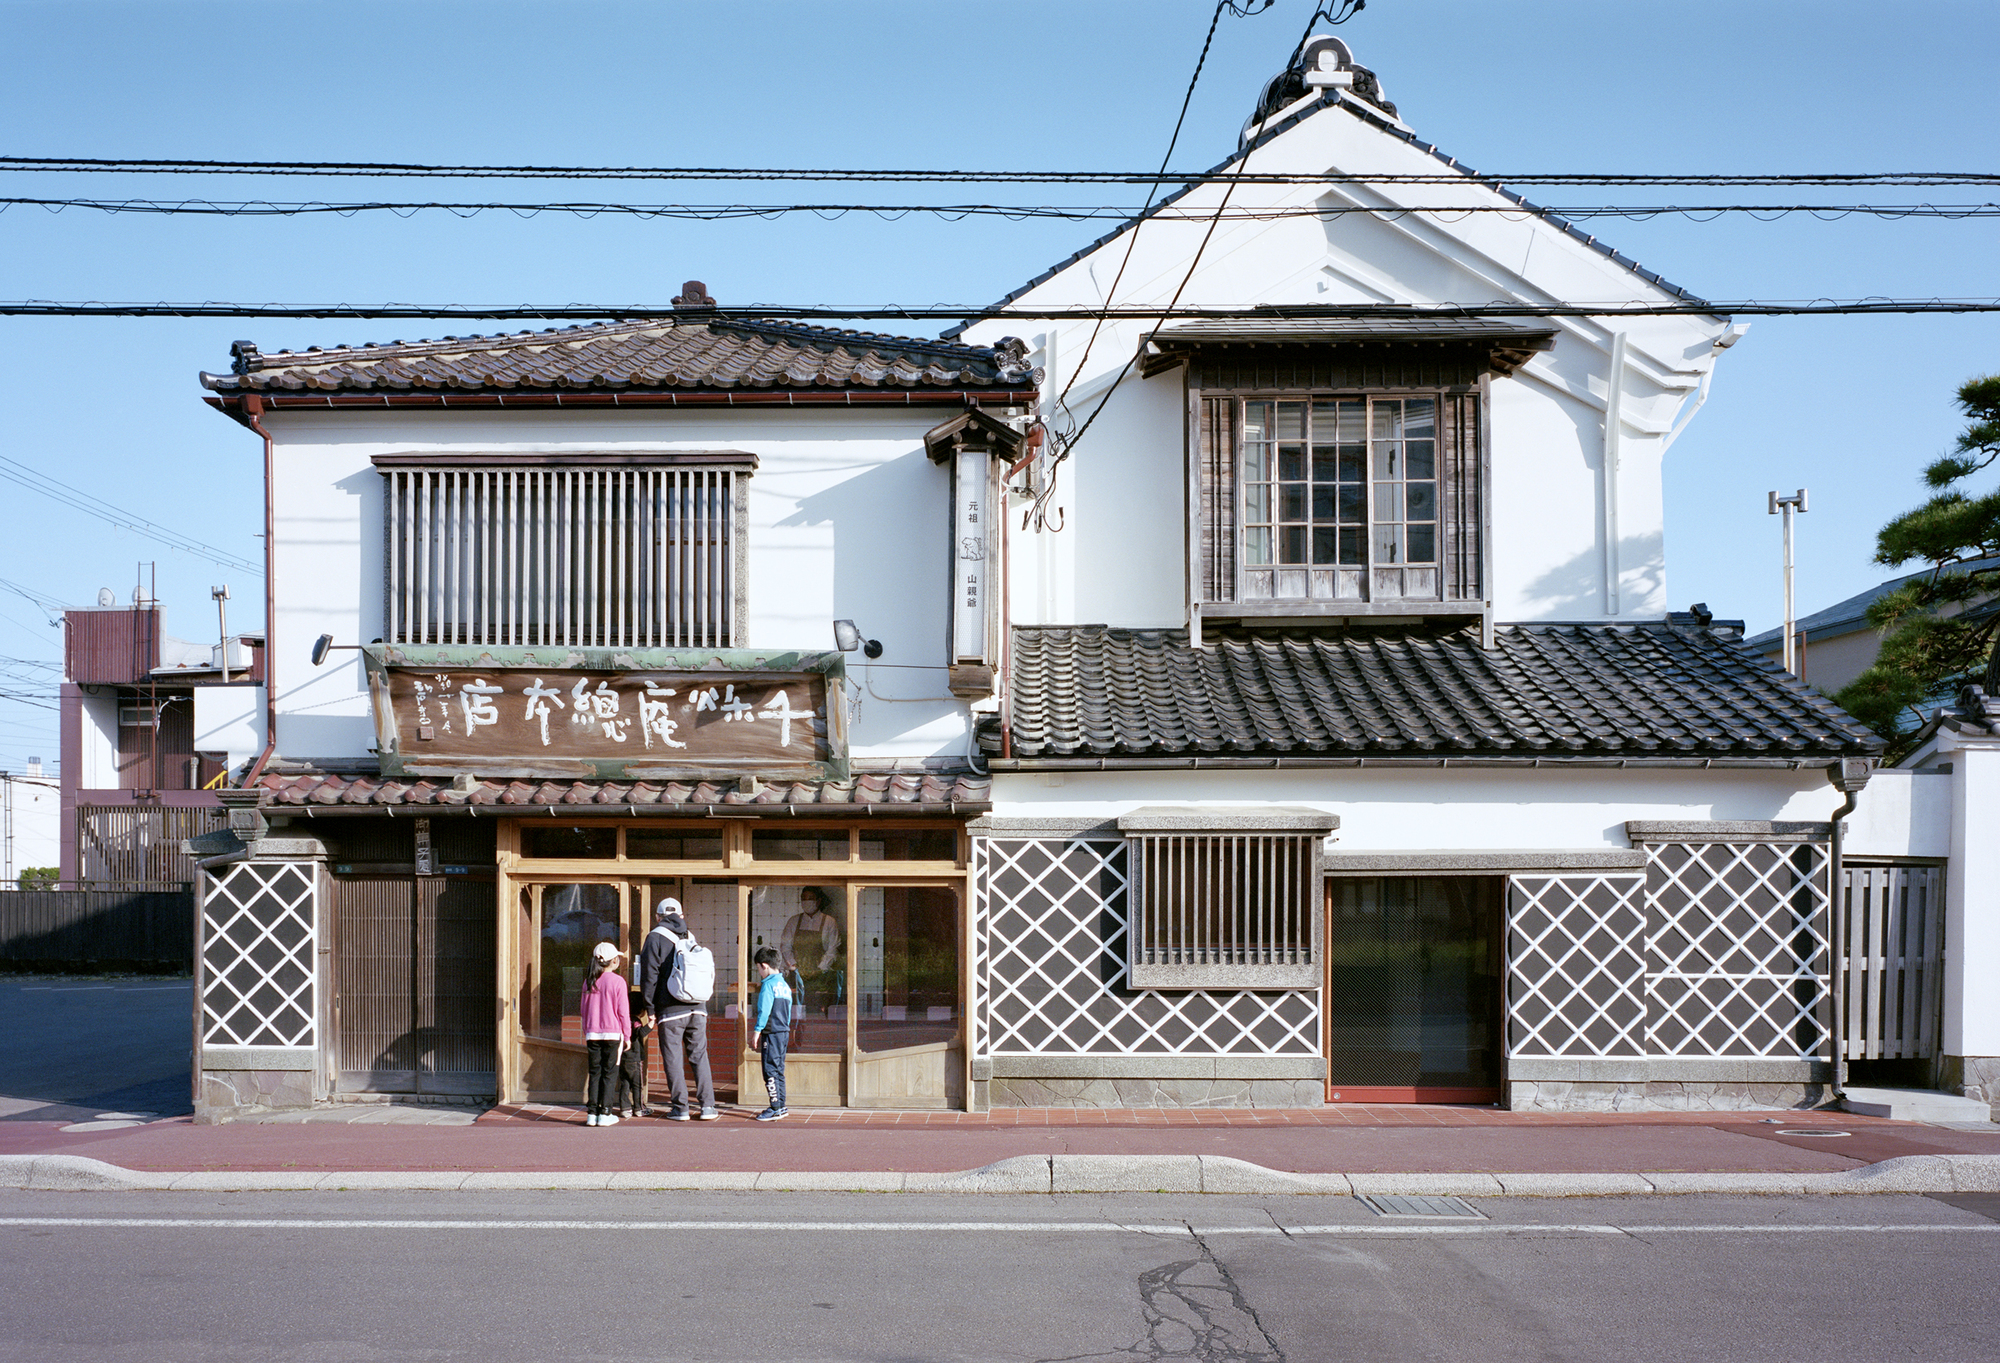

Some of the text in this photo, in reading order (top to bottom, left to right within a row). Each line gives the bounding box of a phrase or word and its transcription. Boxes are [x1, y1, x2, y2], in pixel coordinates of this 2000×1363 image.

[967, 501, 979, 607] 元祖 山親爺
